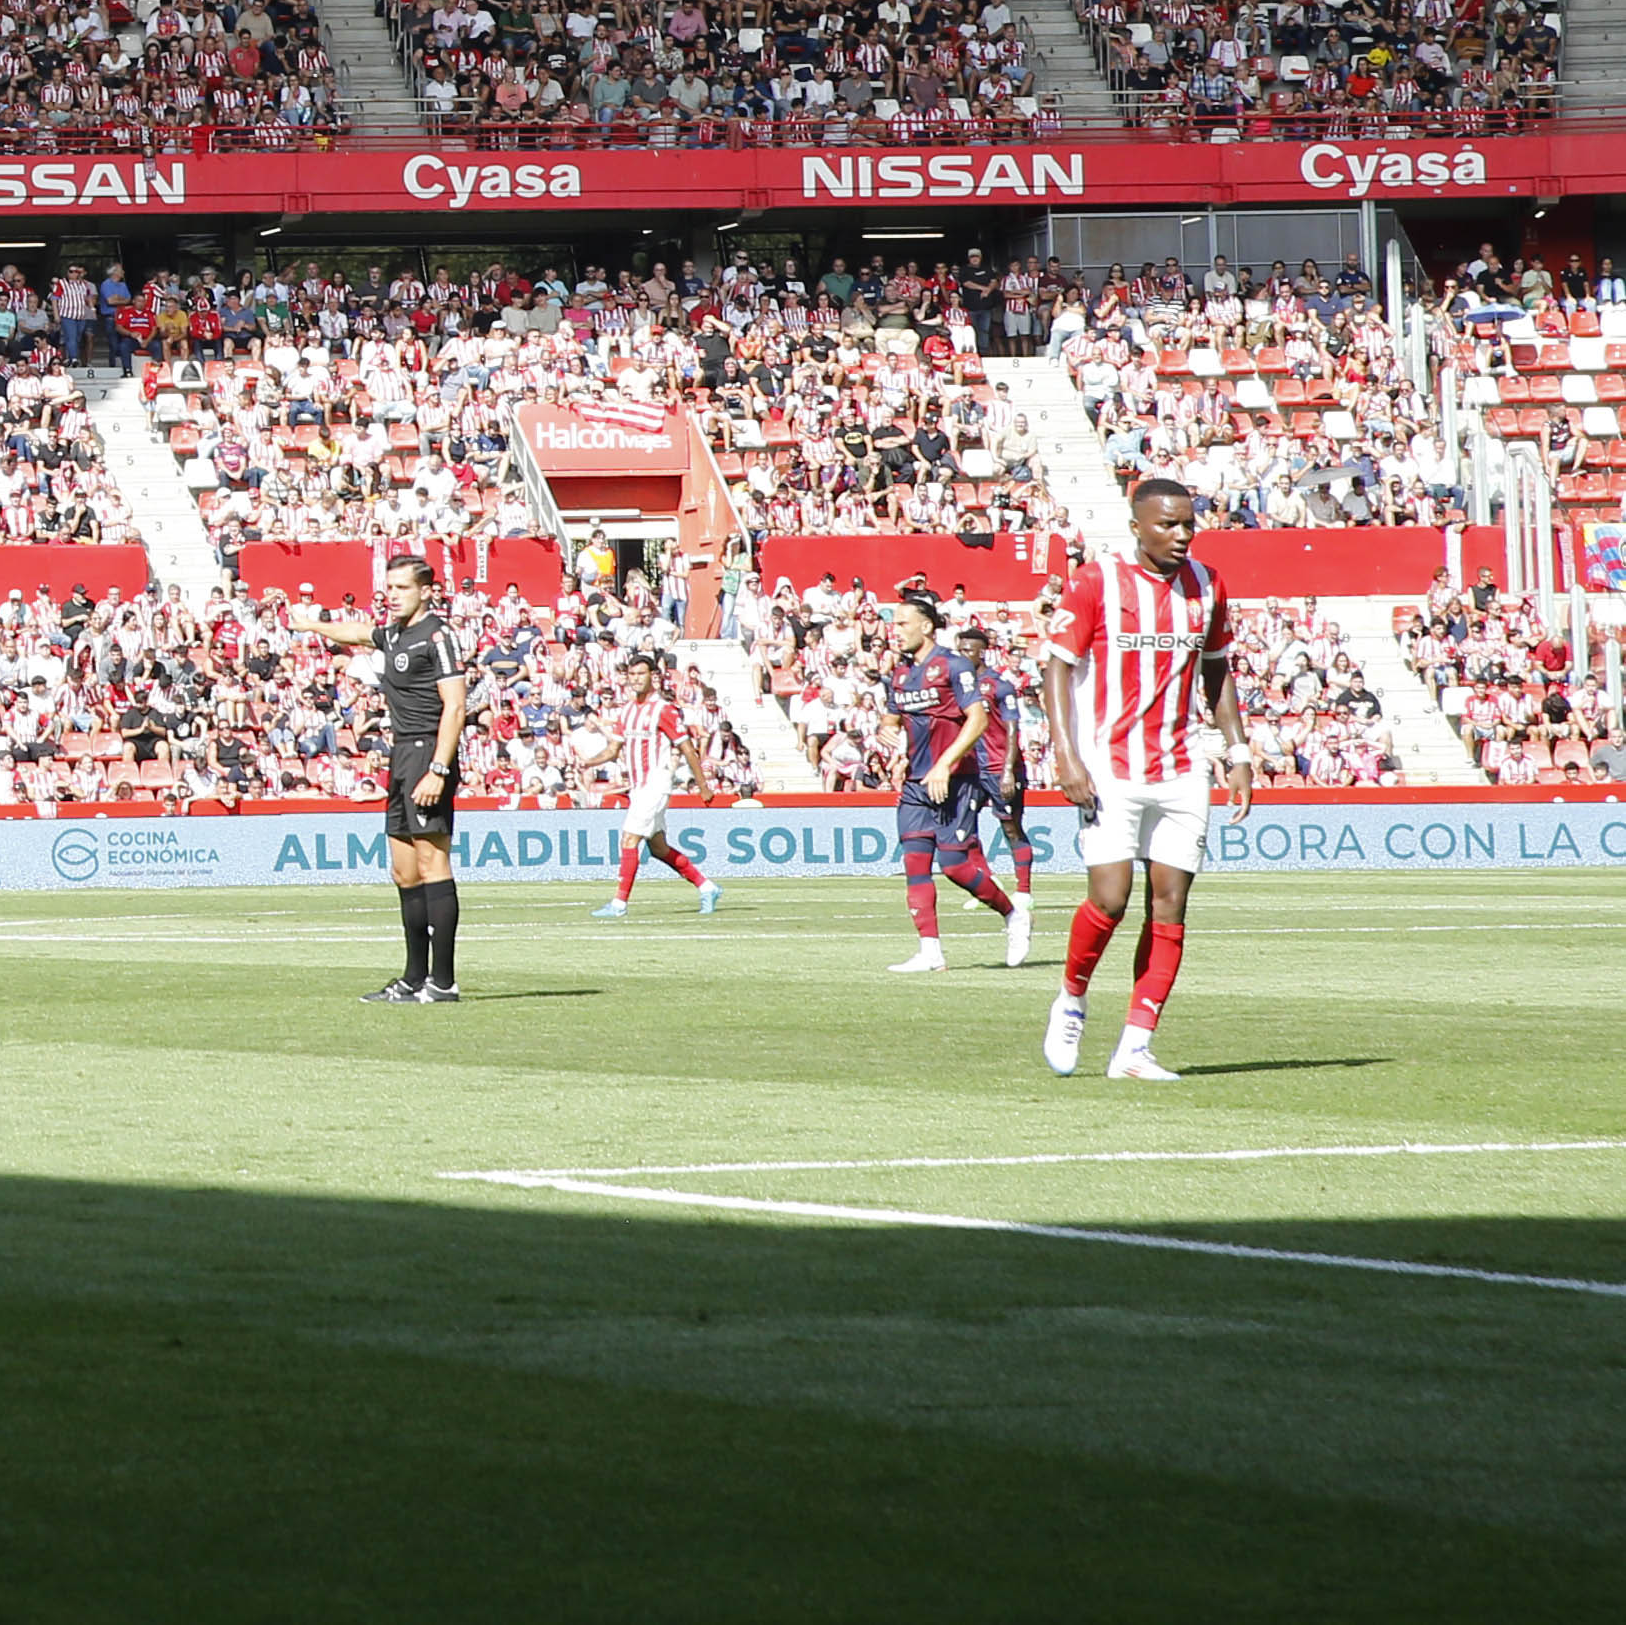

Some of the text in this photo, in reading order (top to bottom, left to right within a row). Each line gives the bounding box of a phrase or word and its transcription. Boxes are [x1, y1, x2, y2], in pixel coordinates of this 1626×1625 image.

[404, 155, 580, 207] Cyasa
[803, 154, 1083, 197] NISSAN
[1301, 144, 1485, 196] Cyasa
[536, 422, 622, 449] Halcón
[107, 830, 179, 847] COCINA
[107, 846, 220, 865] ECONÓMICA
[274, 827, 706, 872] ALMHADILLS
[728, 826, 1055, 864] SOLIDAS
[1385, 823, 1494, 860] CON
[1519, 823, 1581, 859] LA
